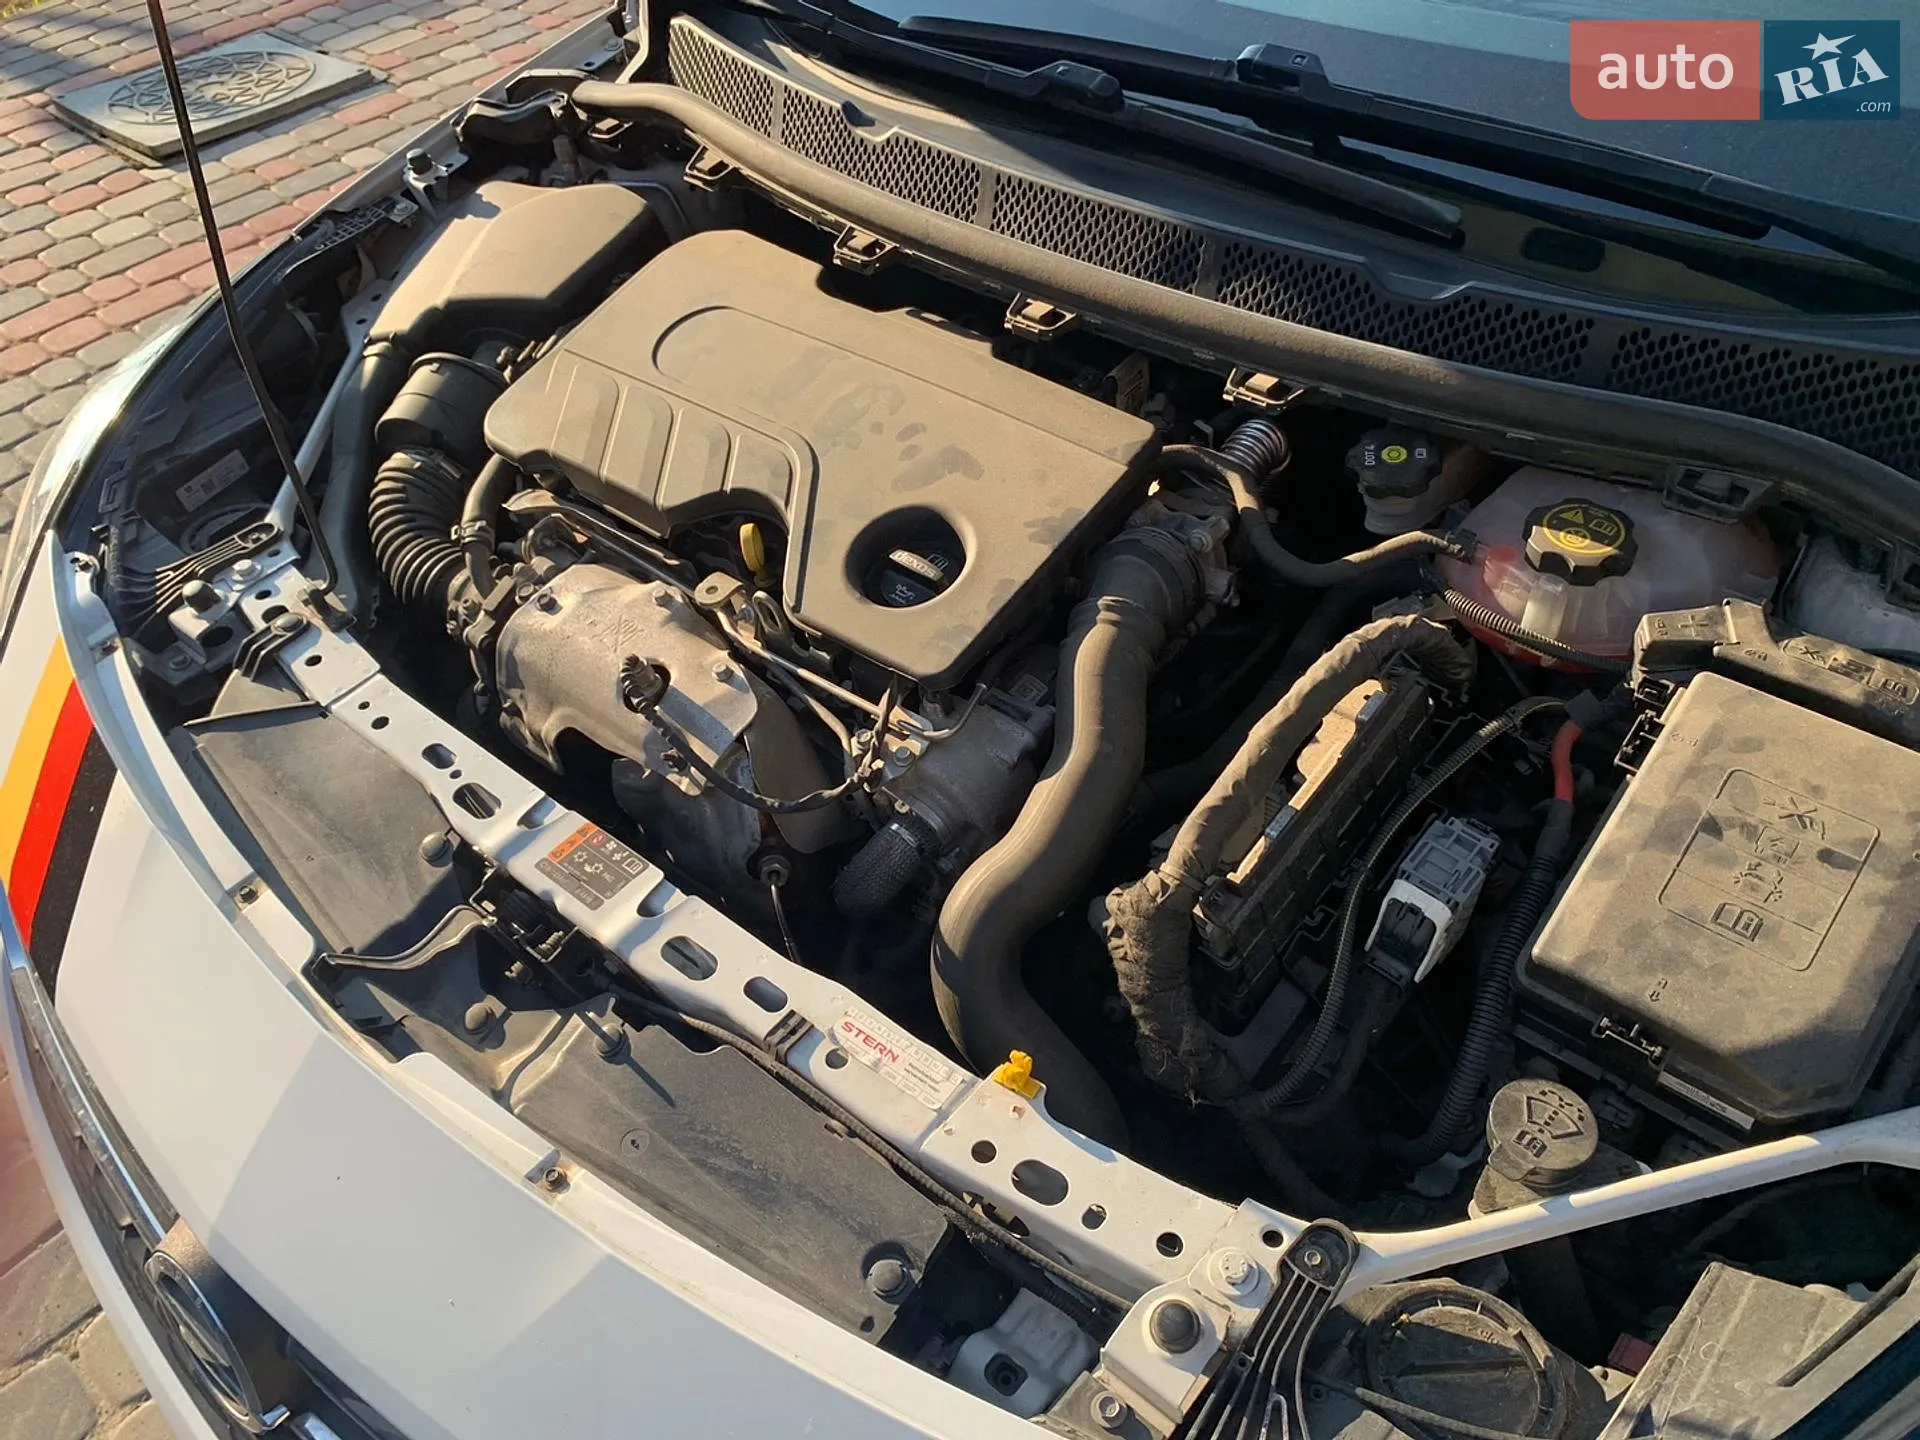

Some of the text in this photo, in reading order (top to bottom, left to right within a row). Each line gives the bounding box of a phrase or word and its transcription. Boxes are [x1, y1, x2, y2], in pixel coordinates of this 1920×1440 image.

[1364, 451, 1376, 466] DOT
[894, 551, 937, 579] dexos
[840, 1020, 900, 1064] STERN
